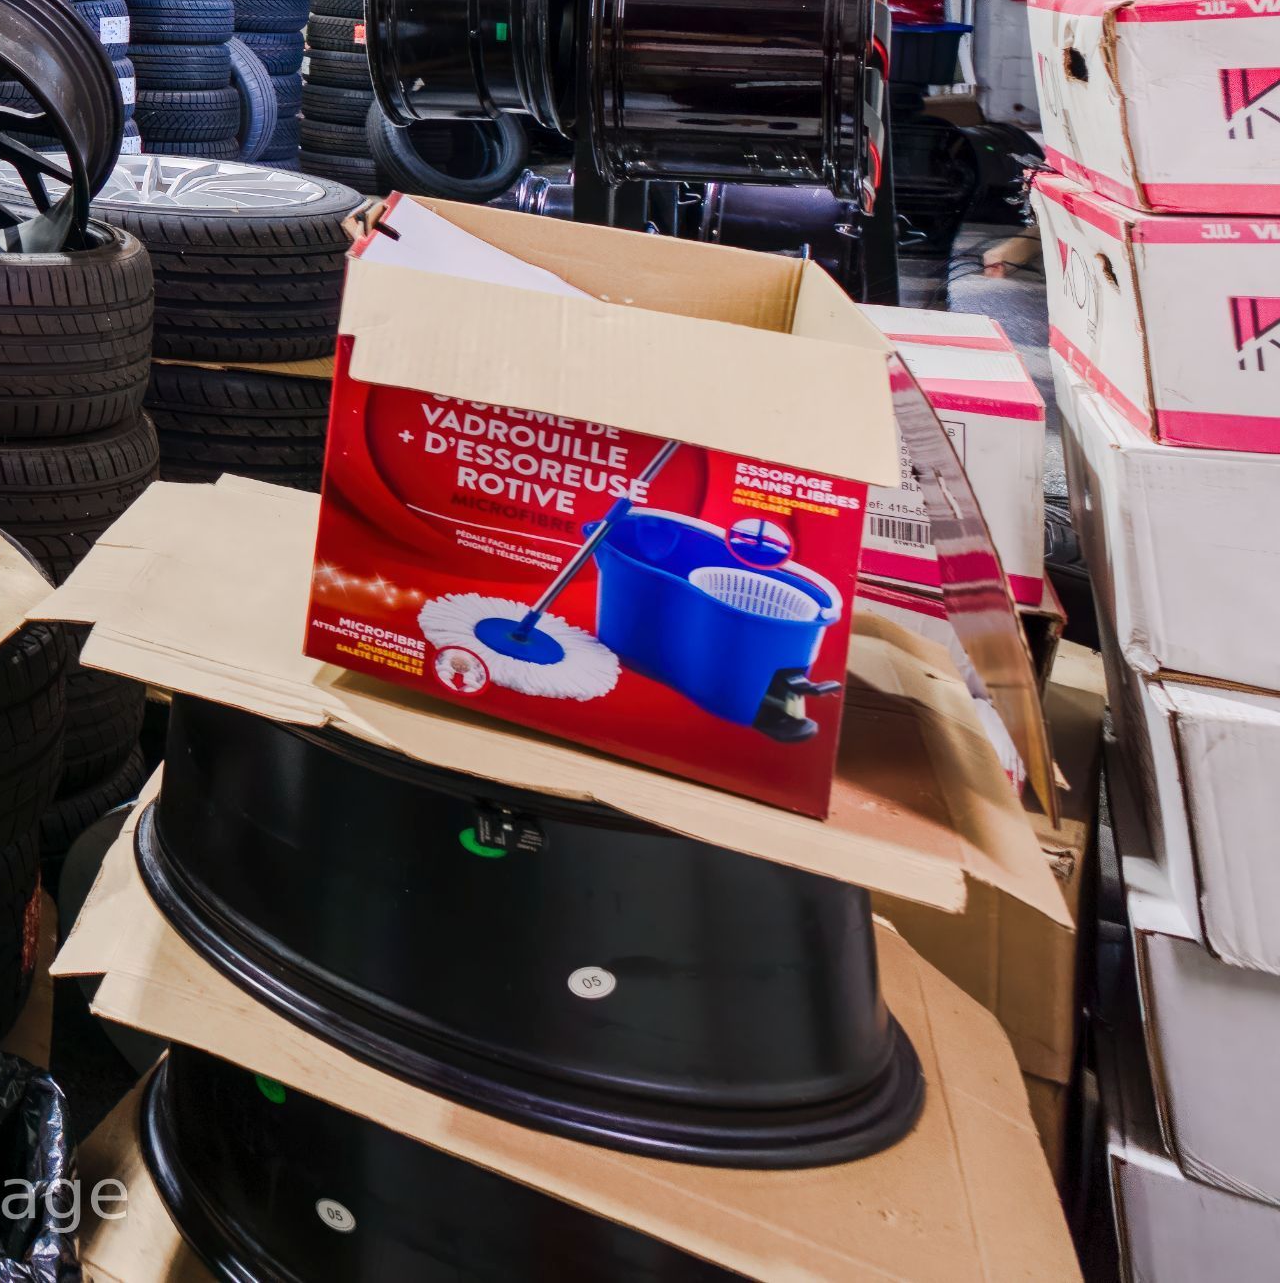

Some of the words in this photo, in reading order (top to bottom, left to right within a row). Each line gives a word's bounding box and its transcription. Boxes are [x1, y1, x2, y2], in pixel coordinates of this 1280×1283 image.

[420, 402, 629, 470] VADROUILLE
[424, 431, 651, 504] D'ESSOREUSE
[736, 462, 834, 493] ESSORAGE
[457, 466, 577, 515] ROTIVE
[732, 488, 766, 501] AVEC
[767, 495, 841, 517] ESSOREUSE
[735, 474, 793, 496] MAINS
[796, 487, 860, 510] LIBRES
[450, 492, 577, 535] MICROFIBRE
[455, 529, 487, 546] PÉDALE
[487, 537, 516, 552] FACILE
[516, 543, 524, 554] À
[525, 547, 563, 565] PRESSER
[457, 538, 495, 555] POIGNÉE
[495, 546, 559, 572] TÉLESCOPIQUE
[312, 619, 360, 639] ATTRACTS
[361, 634, 374, 643] ET
[375, 638, 425, 659] CAPTURES
[339, 617, 426, 651] MICROFIBRE
[357, 641, 411, 663] POUSSIÈRE
[412, 658, 425, 667] ET
[372, 655, 385, 665] ET
